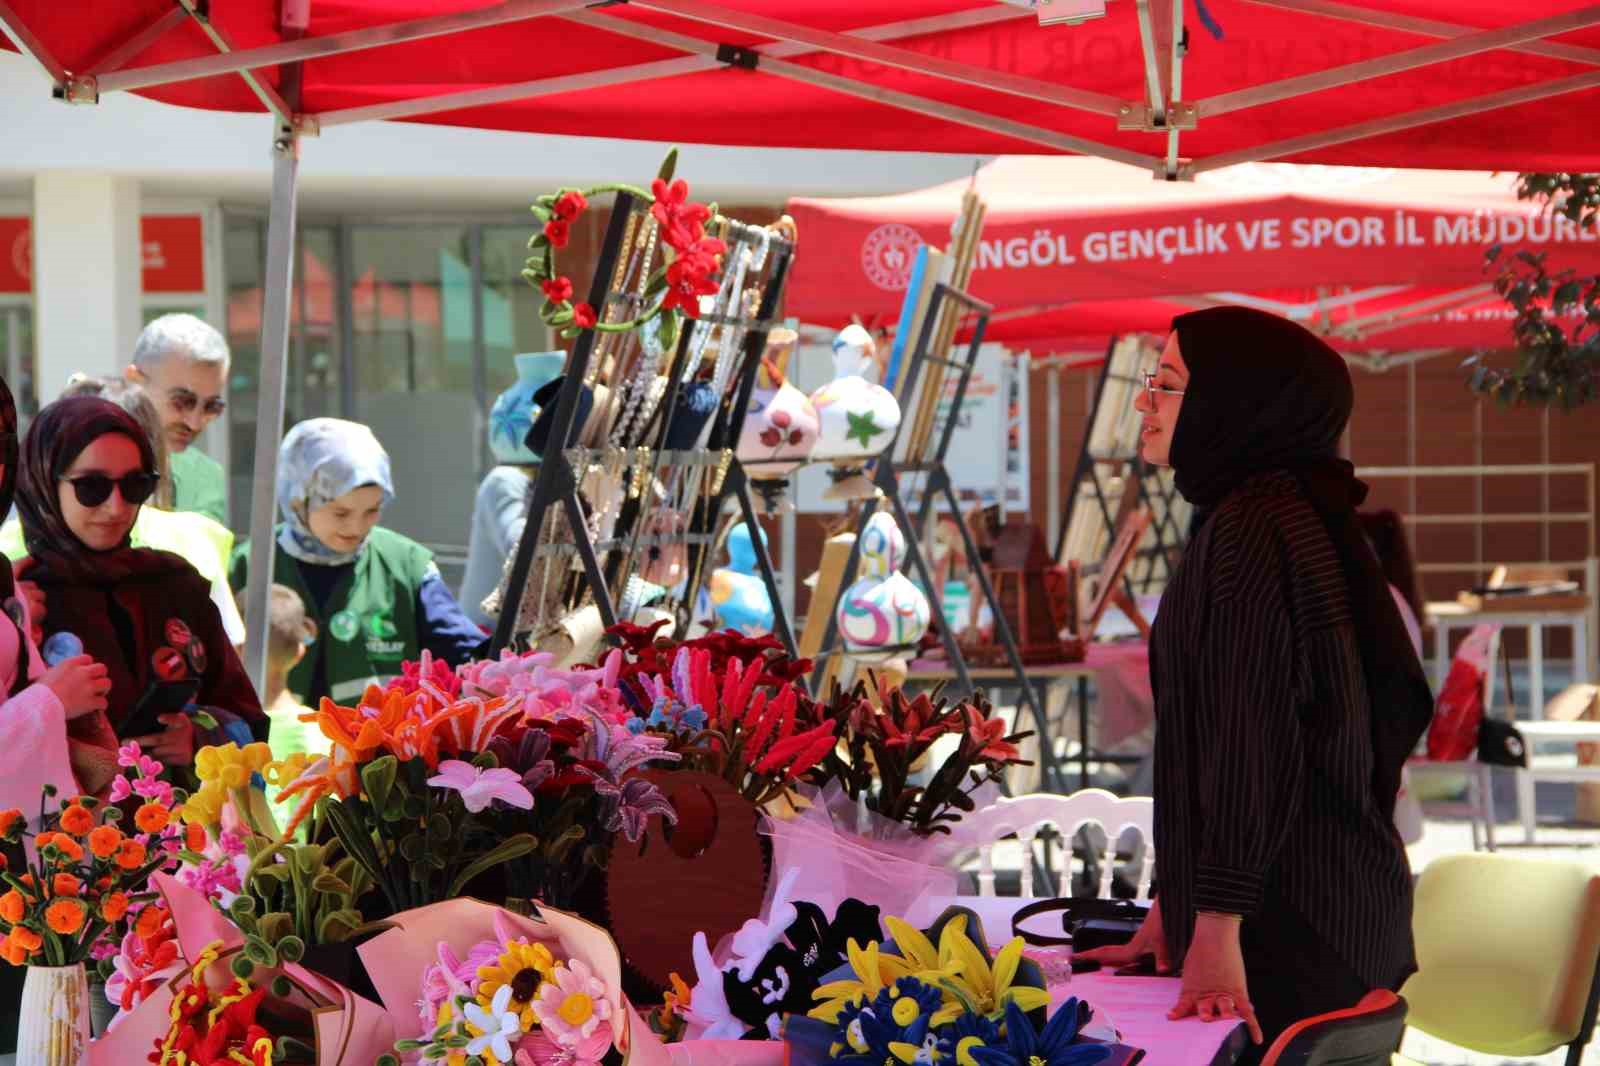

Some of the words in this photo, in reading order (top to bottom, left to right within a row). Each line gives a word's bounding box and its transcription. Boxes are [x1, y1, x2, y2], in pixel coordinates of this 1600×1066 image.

[970, 229, 1077, 270] NGÖL
[1082, 217, 1228, 264] GENÇLİK
[1235, 218, 1282, 252] VE
[1291, 215, 1386, 249] SPOR
[1395, 209, 1426, 247] İL
[1434, 207, 1600, 245] MÜDÜRL
